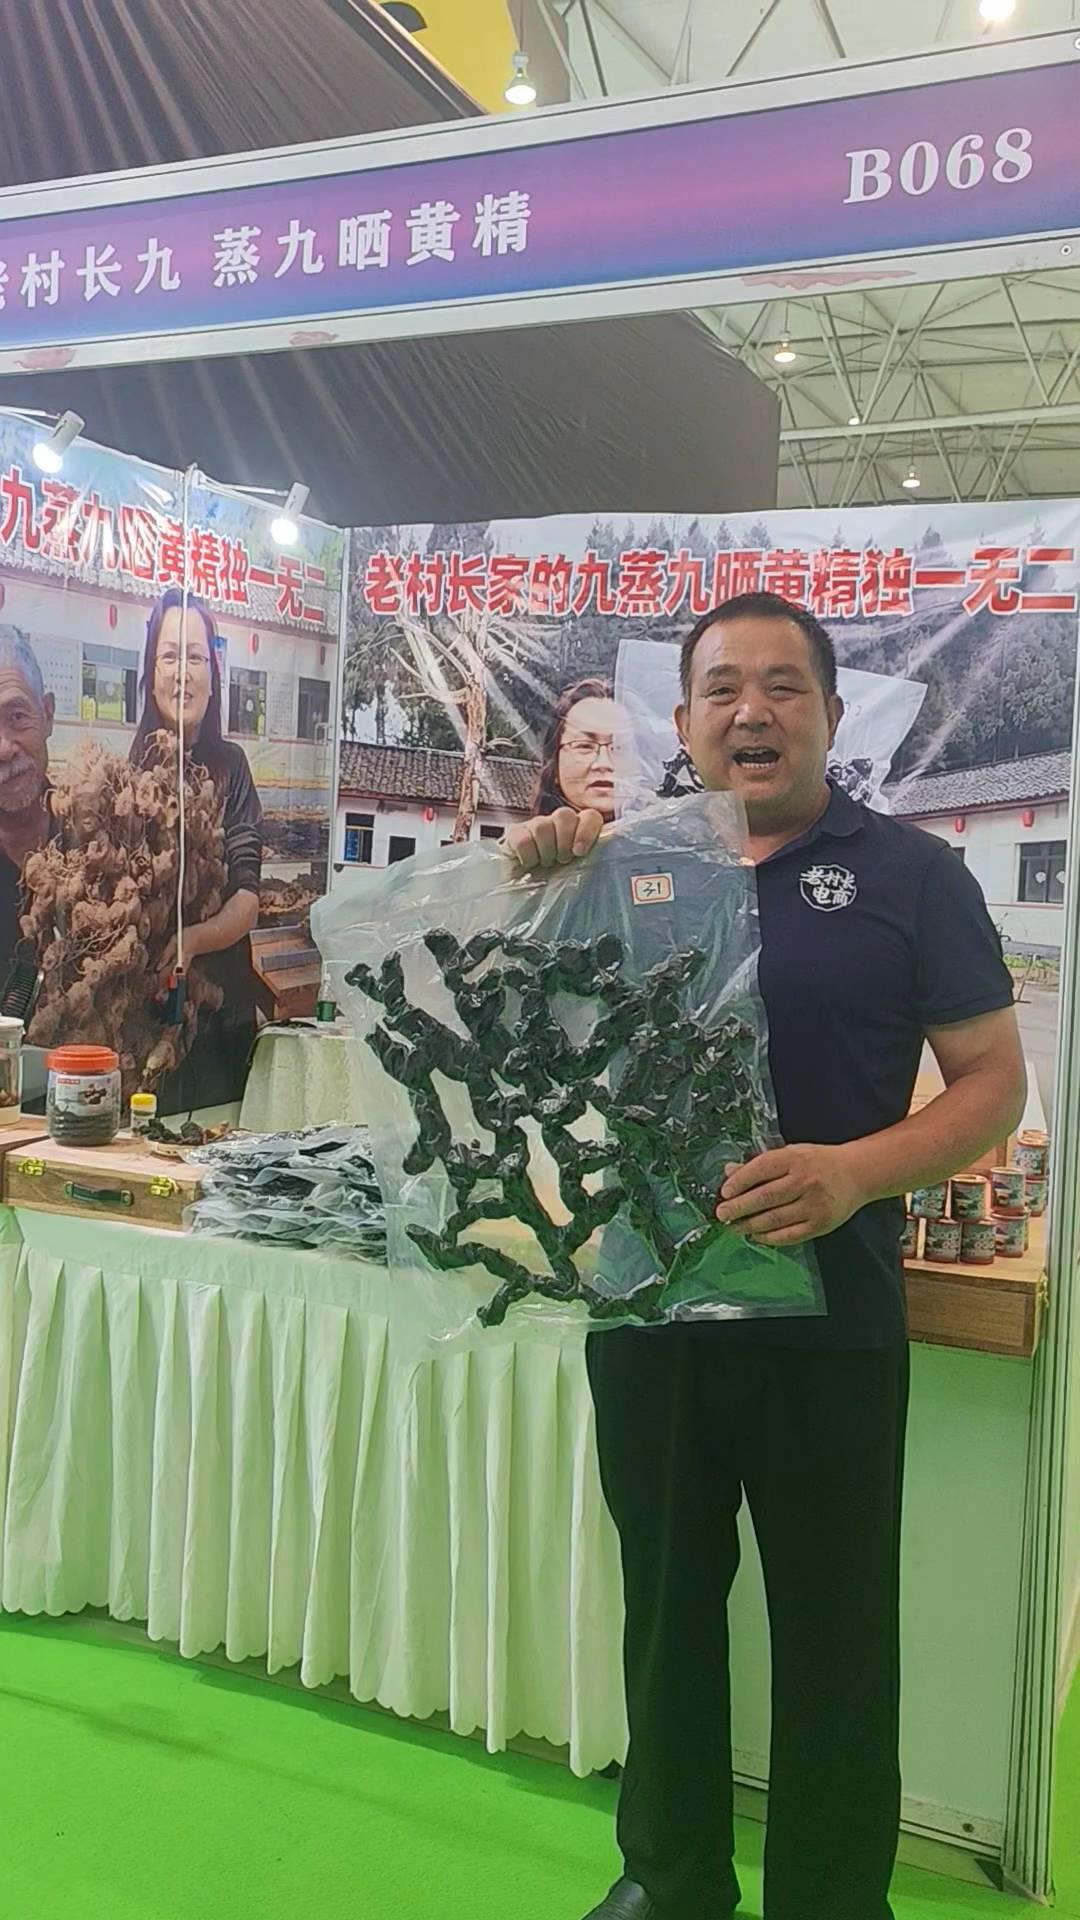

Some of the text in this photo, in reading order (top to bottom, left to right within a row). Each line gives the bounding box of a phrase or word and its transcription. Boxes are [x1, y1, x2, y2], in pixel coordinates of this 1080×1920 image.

[843, 127, 1033, 204] B068
[363, 546, 1077, 617] 老村长家的九蒸九晒黄精独一无二
[799, 865, 856, 889] 老村长
[812, 883, 852, 906] 电商
